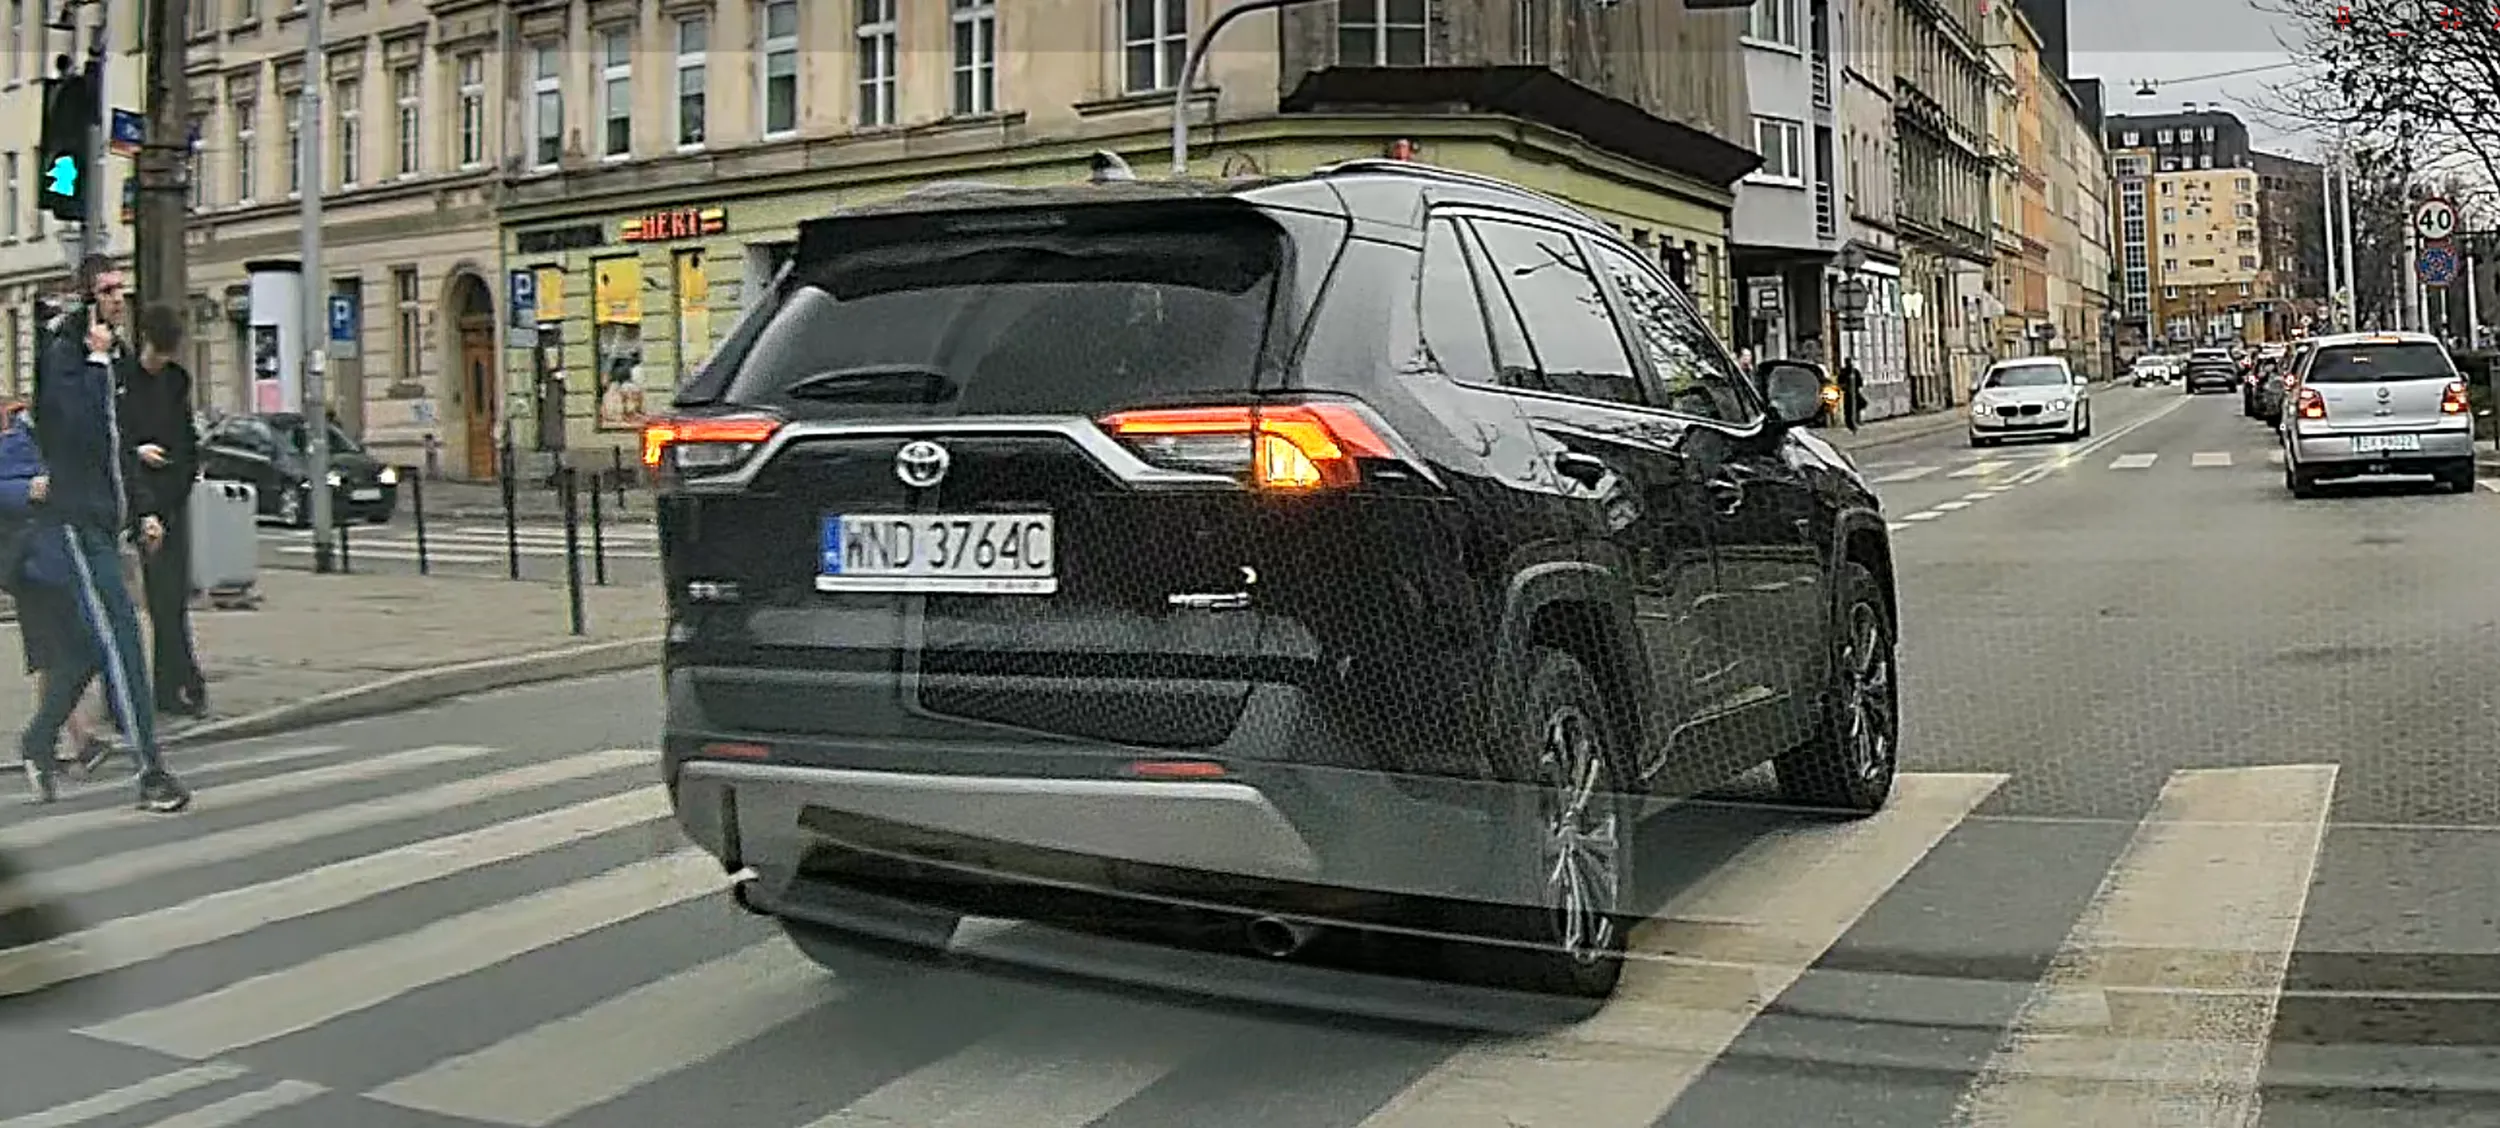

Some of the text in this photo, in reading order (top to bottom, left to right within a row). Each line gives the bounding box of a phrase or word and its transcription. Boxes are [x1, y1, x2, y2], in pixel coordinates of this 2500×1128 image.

[2419, 209, 2451, 230] 40
[515, 273, 531, 303] P
[333, 300, 350, 328] P
[929, 521, 1045, 569] 3764C
